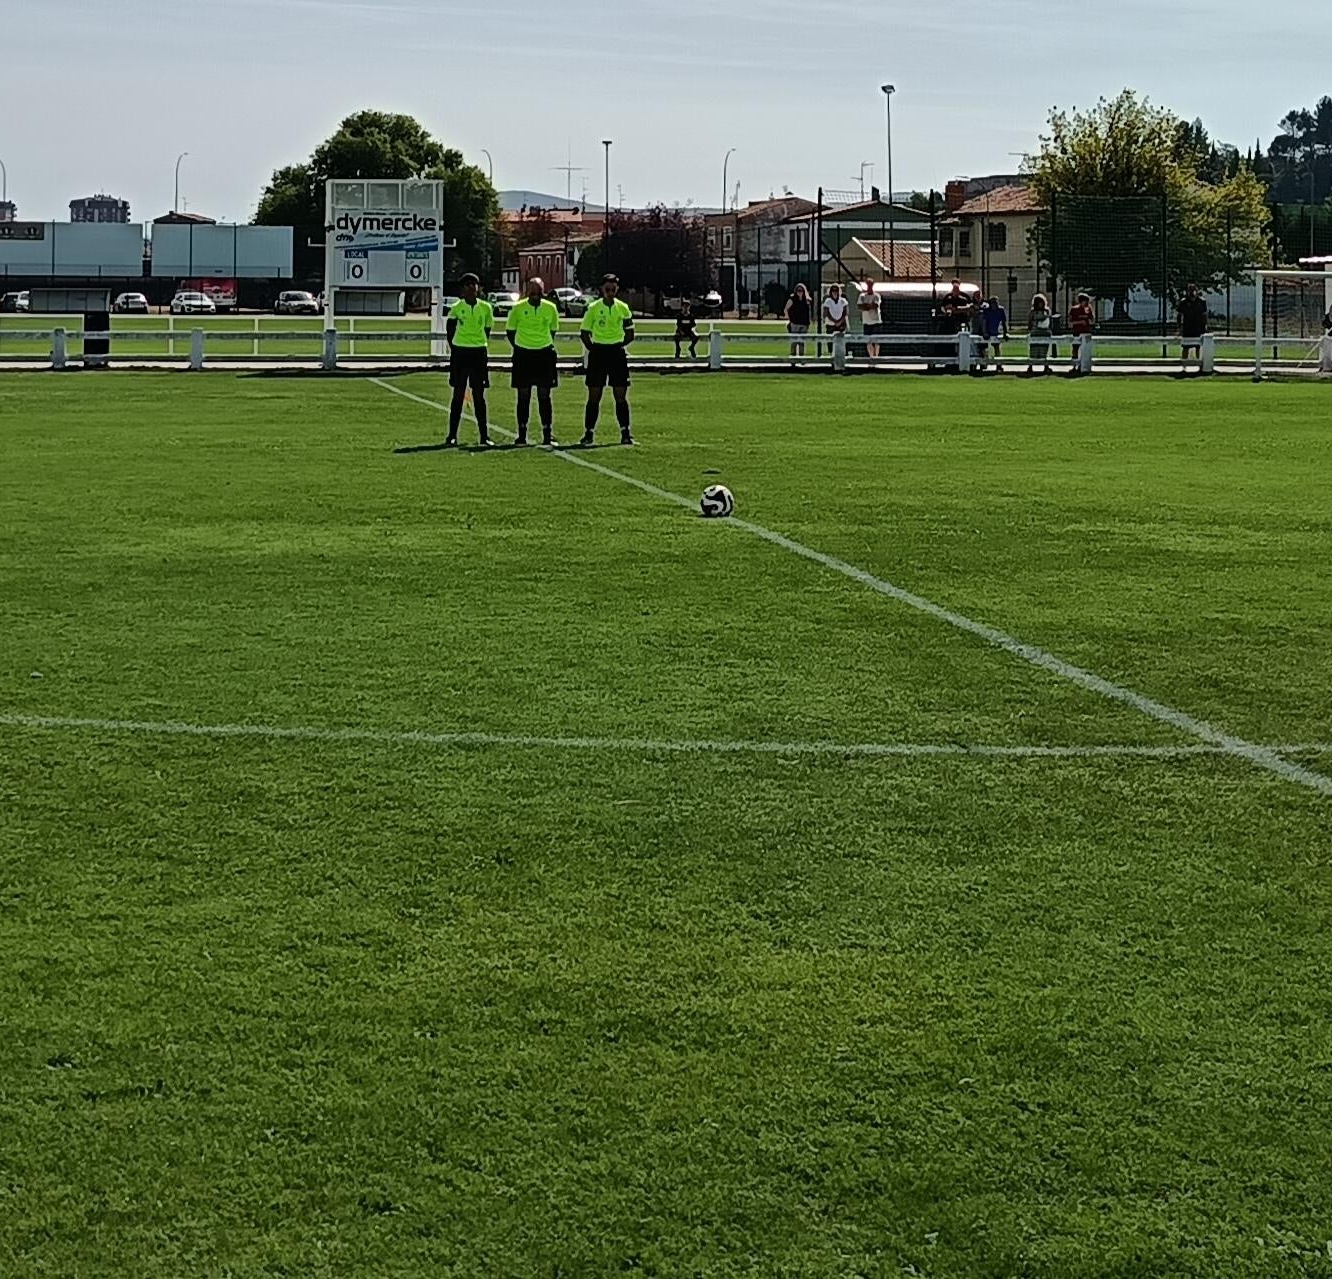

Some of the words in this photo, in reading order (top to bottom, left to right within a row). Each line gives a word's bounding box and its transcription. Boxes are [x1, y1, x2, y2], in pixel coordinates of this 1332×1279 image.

[336, 213, 437, 234] dymercke
[351, 264, 364, 279] 0
[410, 264, 422, 279] 0
